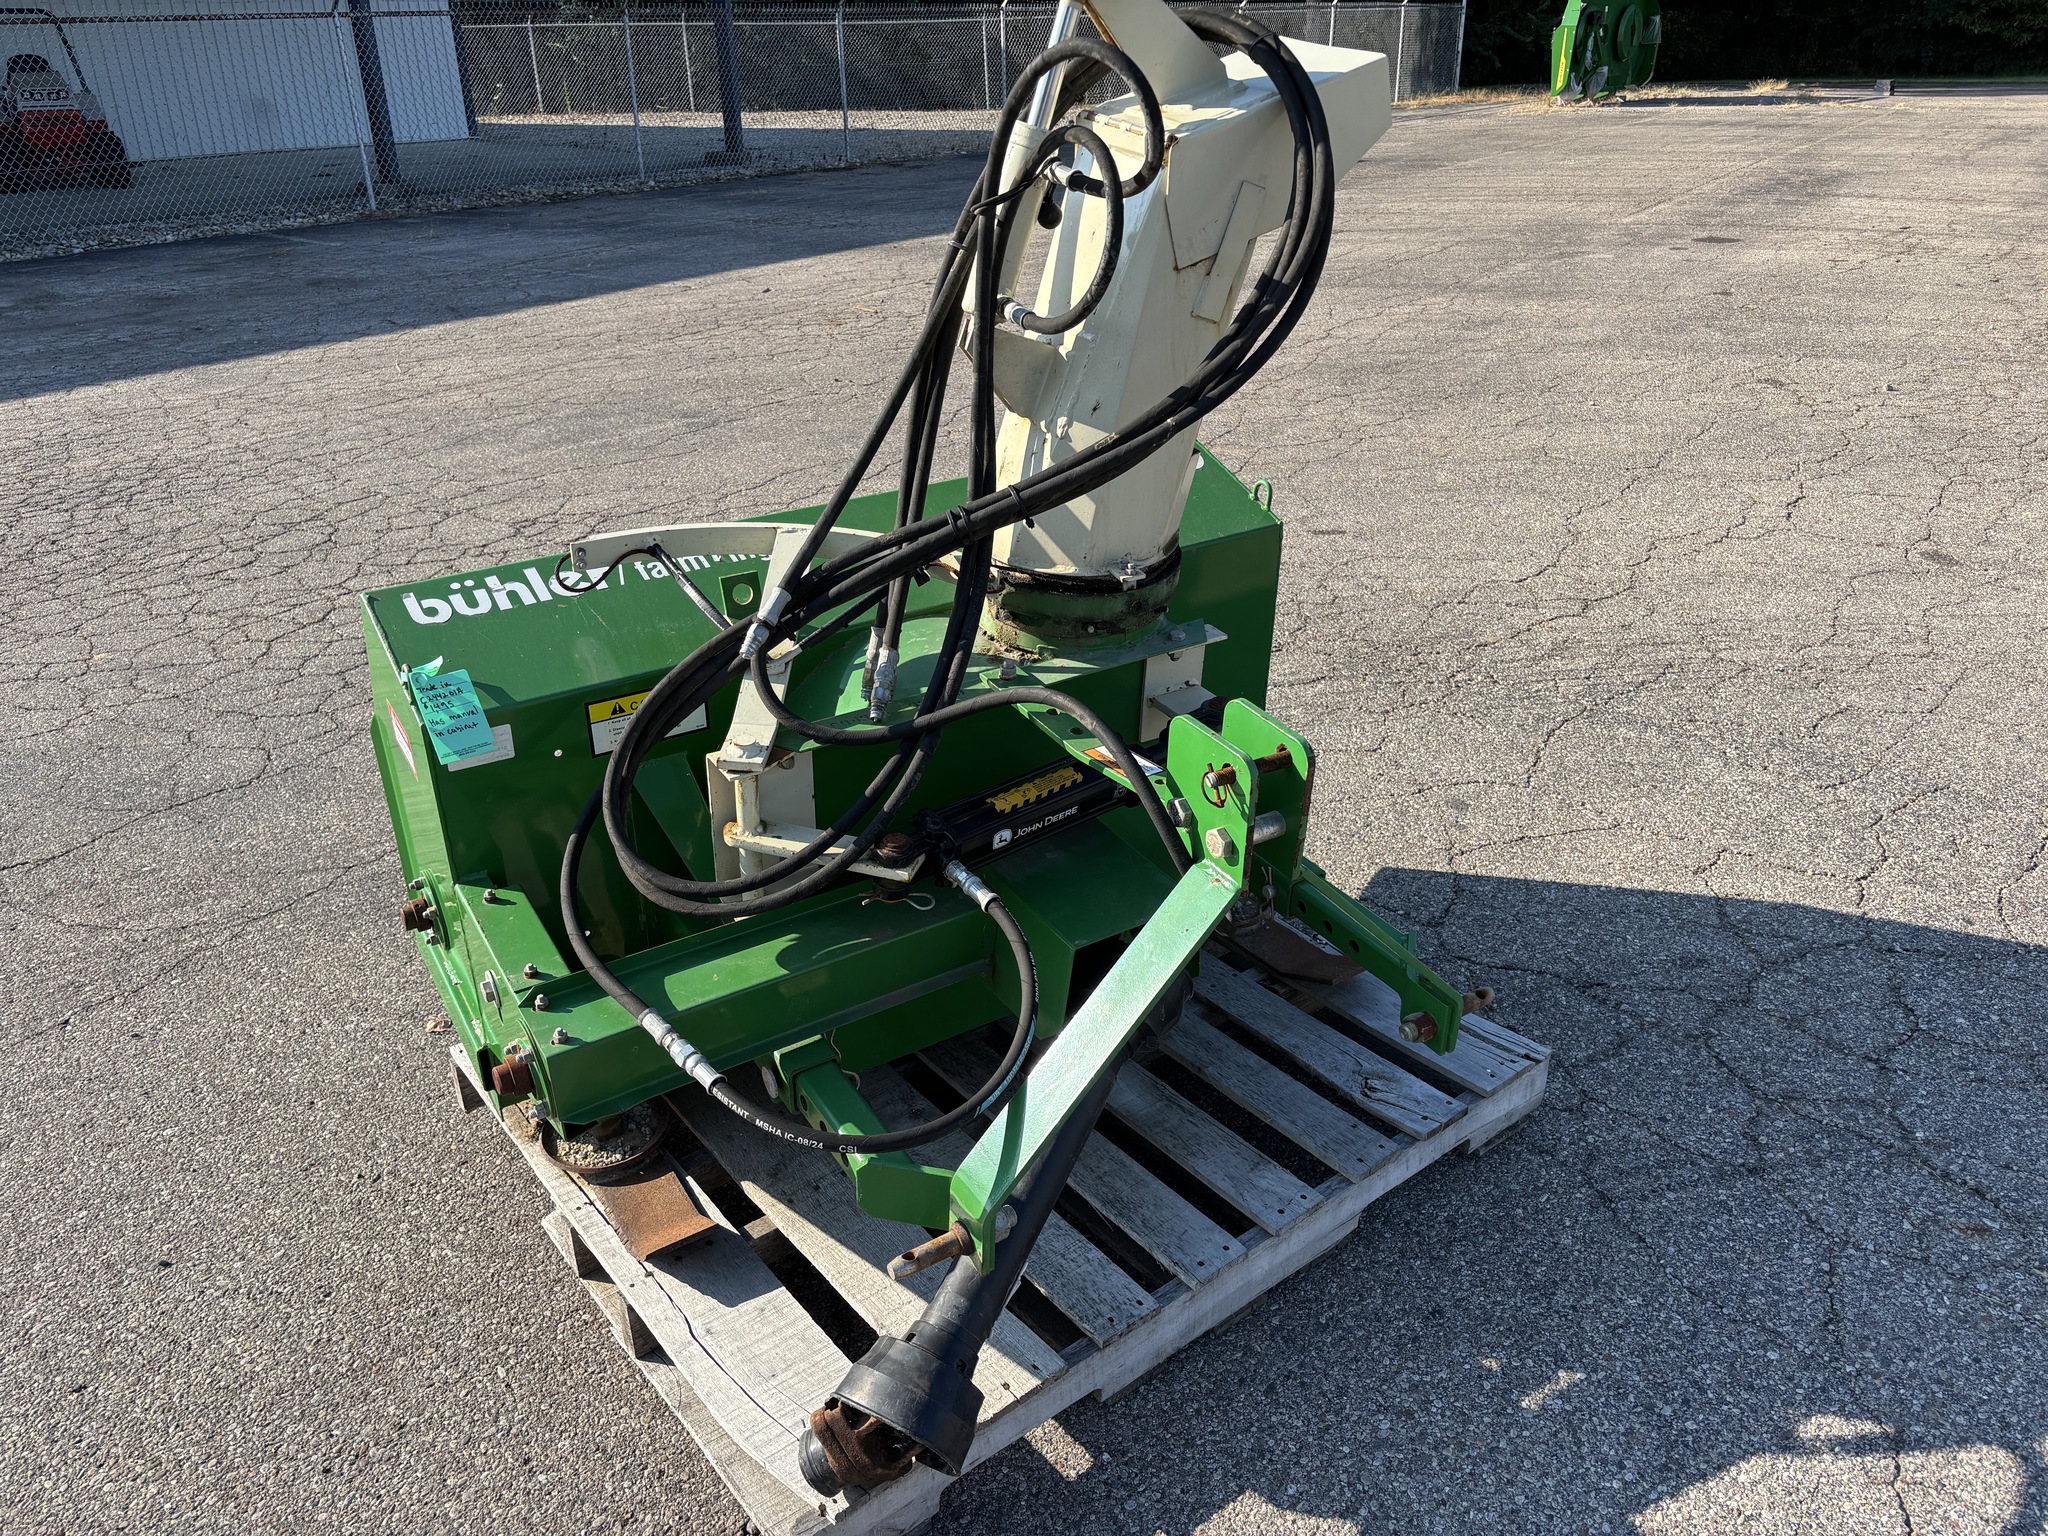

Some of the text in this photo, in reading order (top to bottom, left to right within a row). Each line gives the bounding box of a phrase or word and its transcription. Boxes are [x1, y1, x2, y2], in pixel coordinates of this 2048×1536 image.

[403, 566, 609, 624] bühler
[634, 554, 711, 580] fam
[416, 683, 438, 693] Trade
[428, 718, 445, 728] Has
[433, 730, 445, 738] in
[1014, 805, 1079, 840] JOHN DEERE
[712, 1087, 750, 1119] ESISTANT
[755, 1118, 782, 1138] MSHA
[784, 1130, 824, 1150] IC-08/24
